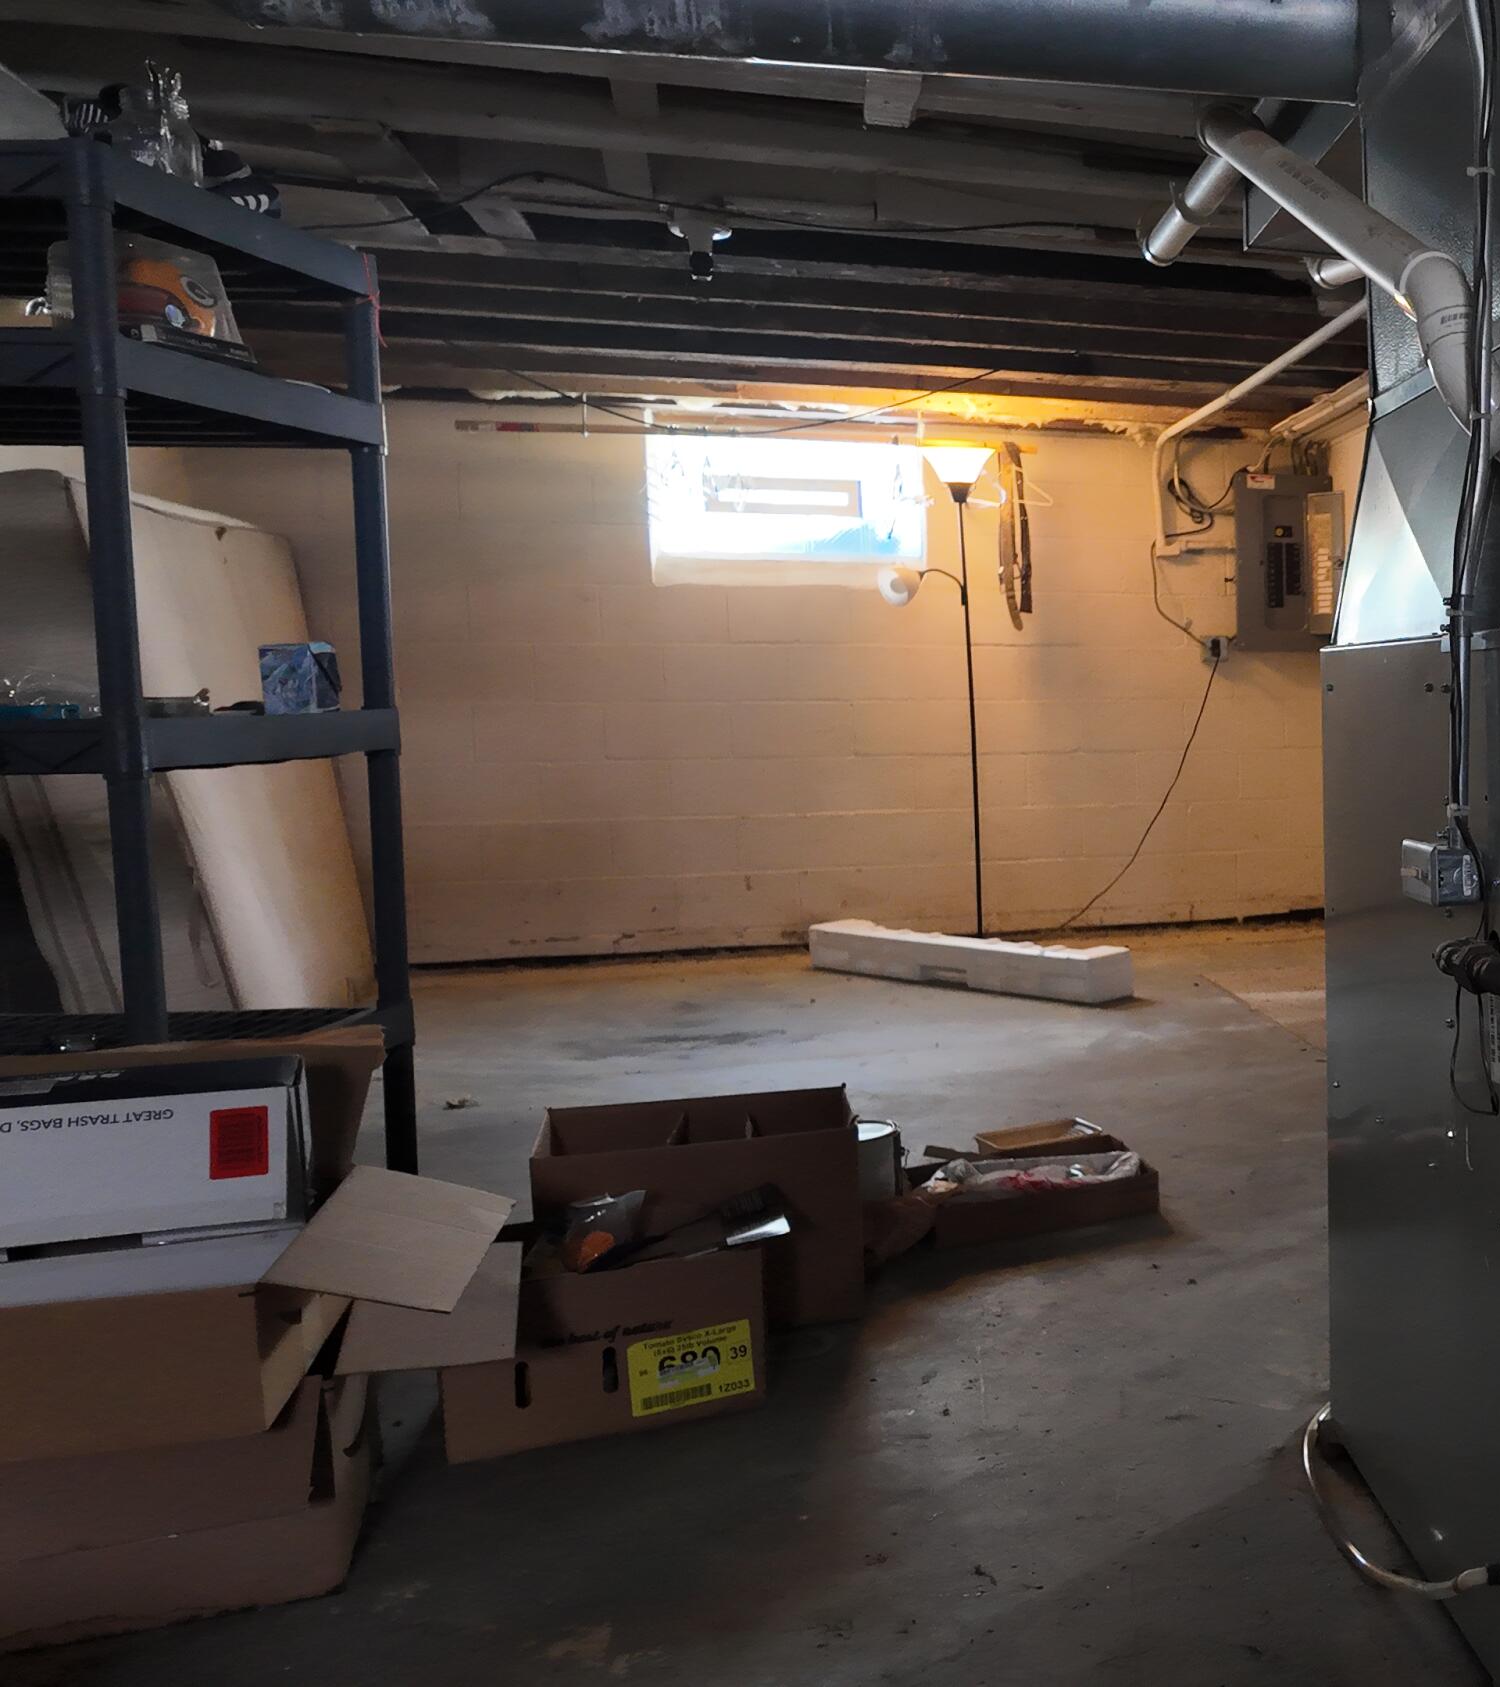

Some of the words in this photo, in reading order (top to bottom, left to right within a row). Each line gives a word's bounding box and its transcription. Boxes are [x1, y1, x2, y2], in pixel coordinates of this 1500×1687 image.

[68, 1112, 119, 1127] TRASH
[124, 1108, 174, 1123] GREAT
[17, 1117, 63, 1132] BAGS,
[728, 1344, 748, 1360] 39
